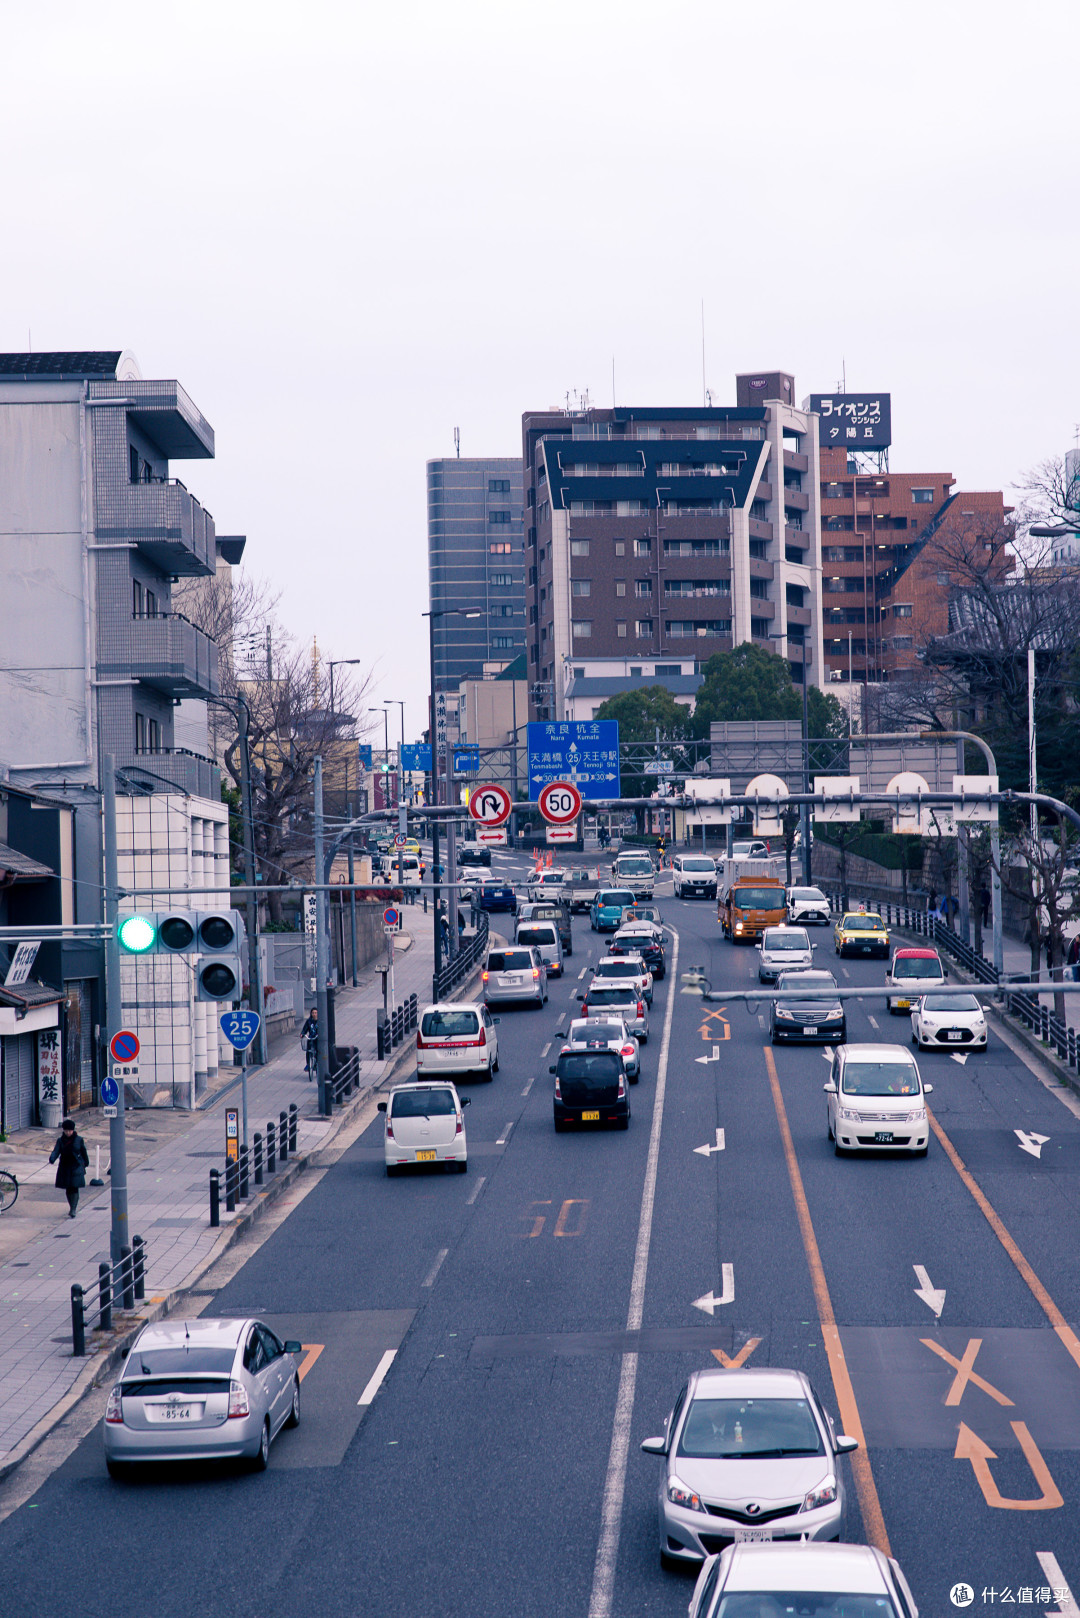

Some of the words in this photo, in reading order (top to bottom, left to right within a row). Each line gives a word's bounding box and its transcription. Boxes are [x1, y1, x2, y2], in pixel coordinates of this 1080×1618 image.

[820, 399, 881, 417] ライオンズ
[851, 416, 881, 424] マンション
[829, 427, 874, 438] 夕陽丘
[545, 724, 569, 734] 奈良
[576, 723, 600, 734] 杭全
[530, 752, 563, 763] 天満橋
[568, 753, 579, 763] 25
[583, 750, 618, 761] 天王寺駅
[549, 794, 571, 812] 50
[229, 1020, 252, 1035] 25
[114, 1066, 139, 1076] 自動車
[166, 1409, 190, 1419] 85-64
